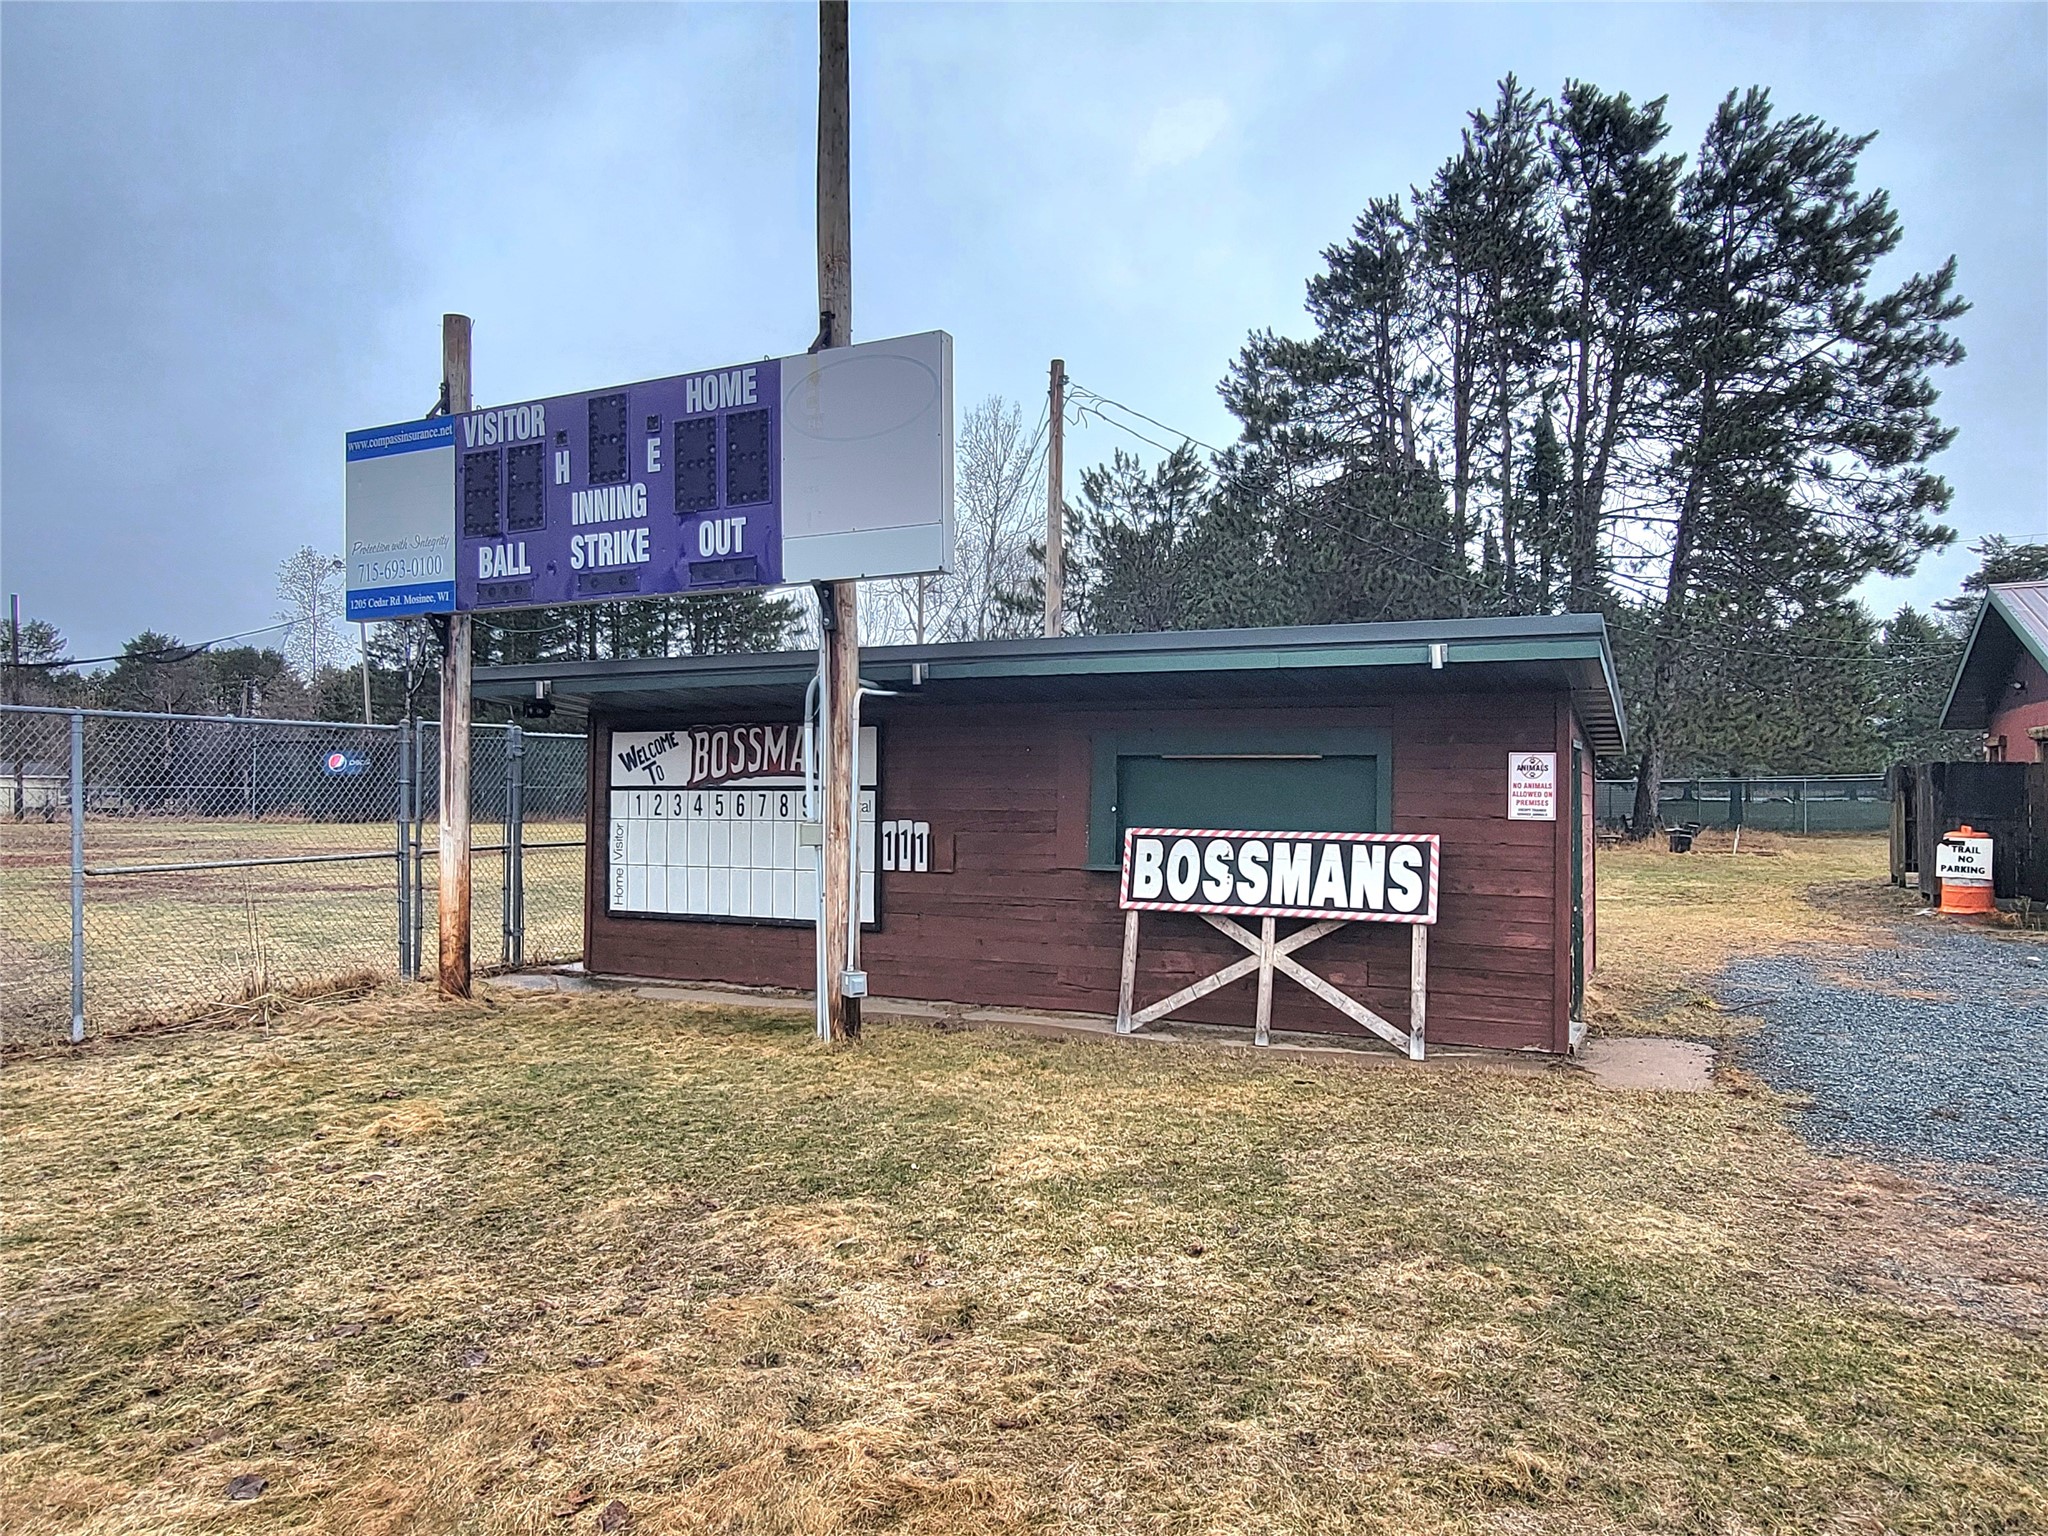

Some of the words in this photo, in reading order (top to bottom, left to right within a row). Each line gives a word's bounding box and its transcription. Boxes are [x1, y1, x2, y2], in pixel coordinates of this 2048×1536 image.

[686, 367, 757, 414] HOME
[347, 424, 453, 452] www.compassinsurance.net
[463, 403, 546, 448] VISITOR
[555, 450, 571, 485] H
[647, 437, 662, 474] E
[571, 482, 648, 526] INNING
[351, 541, 390, 556] Protection
[391, 537, 408, 551] with
[409, 534, 450, 553] Integrity
[570, 527, 650, 571] STRIKE
[698, 516, 747, 557] OUT
[358, 555, 443, 583] 715-693-0100
[479, 541, 532, 580] BALL
[350, 600, 367, 610] 1205
[367, 597, 388, 608] Cedar
[437, 591, 450, 602] WI
[635, 793, 642, 817] 1
[654, 793, 662, 816] 2
[673, 793, 682, 817] 3
[693, 793, 703, 817] 4
[715, 793, 724, 817] 5
[736, 793, 745, 817] 6
[758, 793, 767, 817] 7
[779, 793, 789, 818] 8
[613, 822, 625, 860] Visitor
[1951, 846, 1981, 854] TRAIL
[613, 867, 625, 906] Home
[1131, 837, 1424, 913] BOSSMANS
[1941, 865, 1986, 874] PARKING
